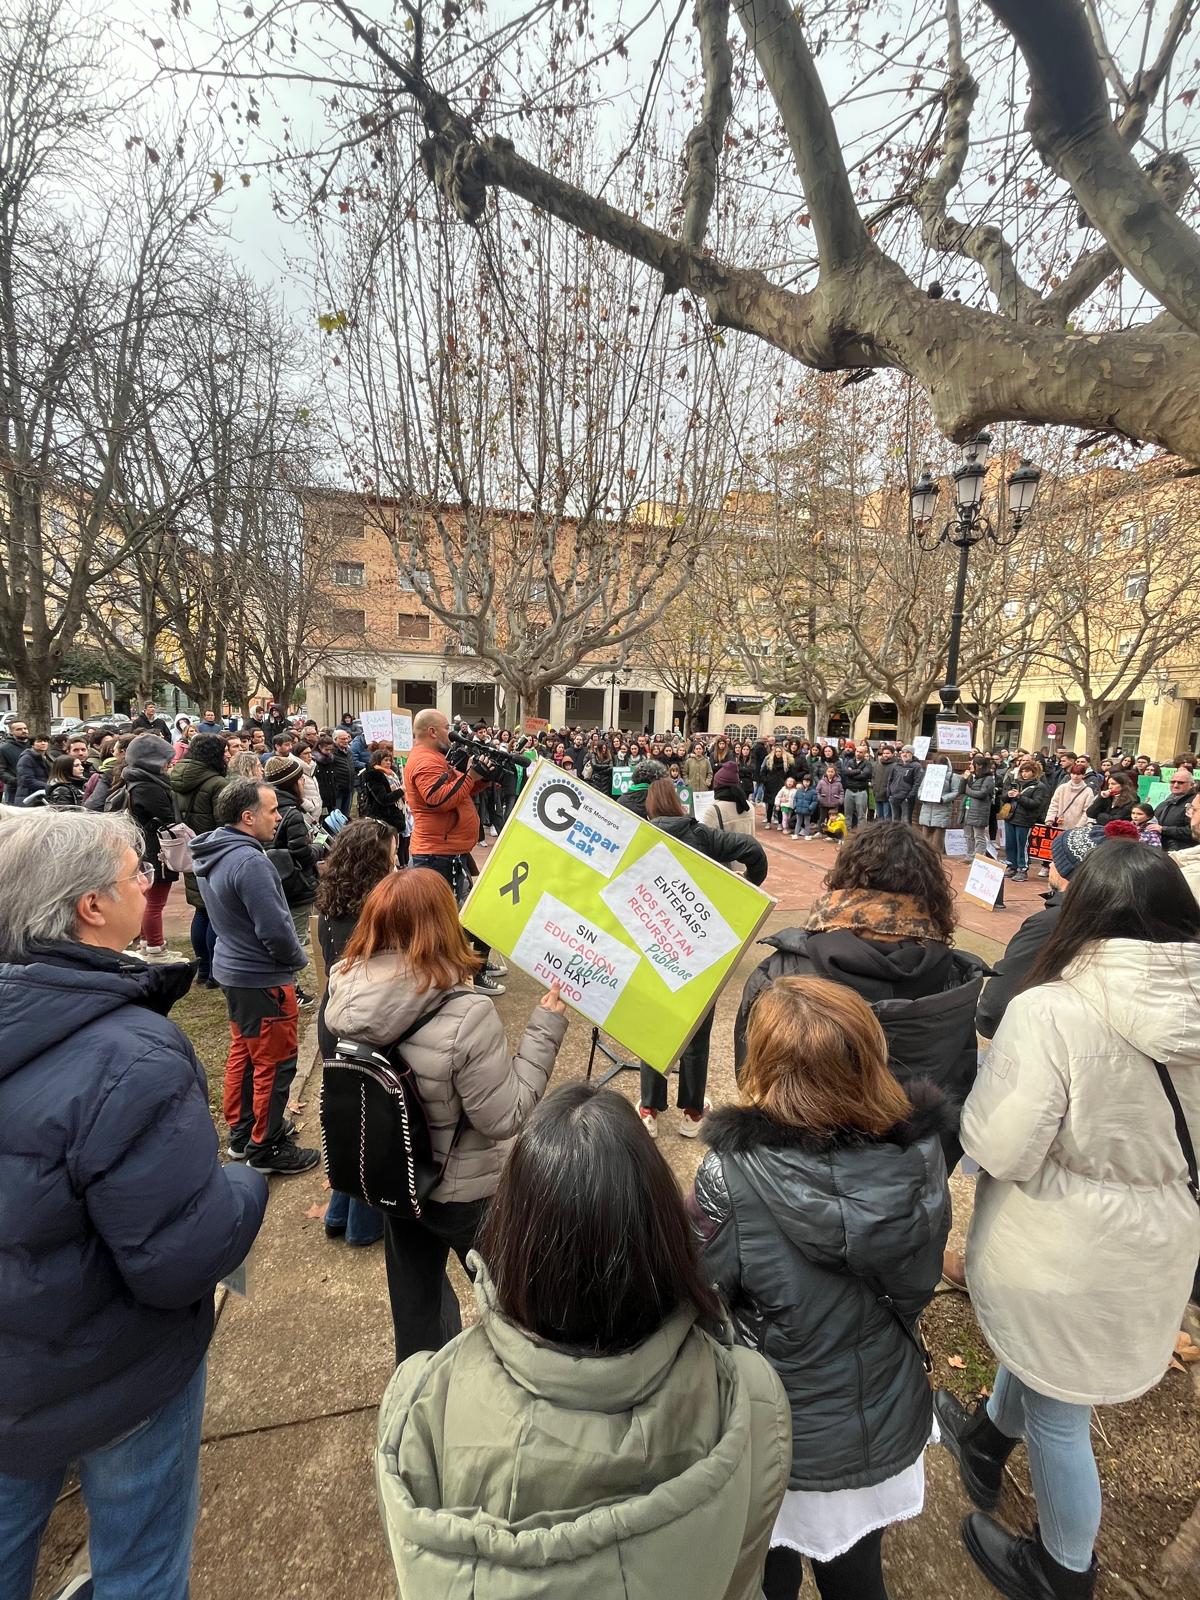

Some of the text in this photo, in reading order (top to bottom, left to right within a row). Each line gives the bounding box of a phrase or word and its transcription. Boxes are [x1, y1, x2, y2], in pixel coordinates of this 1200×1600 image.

[582, 804, 620, 830] IES Monegros
[1031, 826, 1047, 837] SE
[566, 830, 595, 856] Lax
[653, 875, 707, 939] ENTERÁIS?
[671, 879, 711, 921] ¿NO OS
[576, 924, 598, 944] SIN
[628, 897, 679, 961] RECURSOS
[635, 884, 694, 957] NOS FALTAN
[544, 920, 616, 976] EDUCACIÓN
[645, 943, 693, 980] Públicos
[544, 951, 590, 988] NO HAY
[565, 953, 618, 989] Pública
